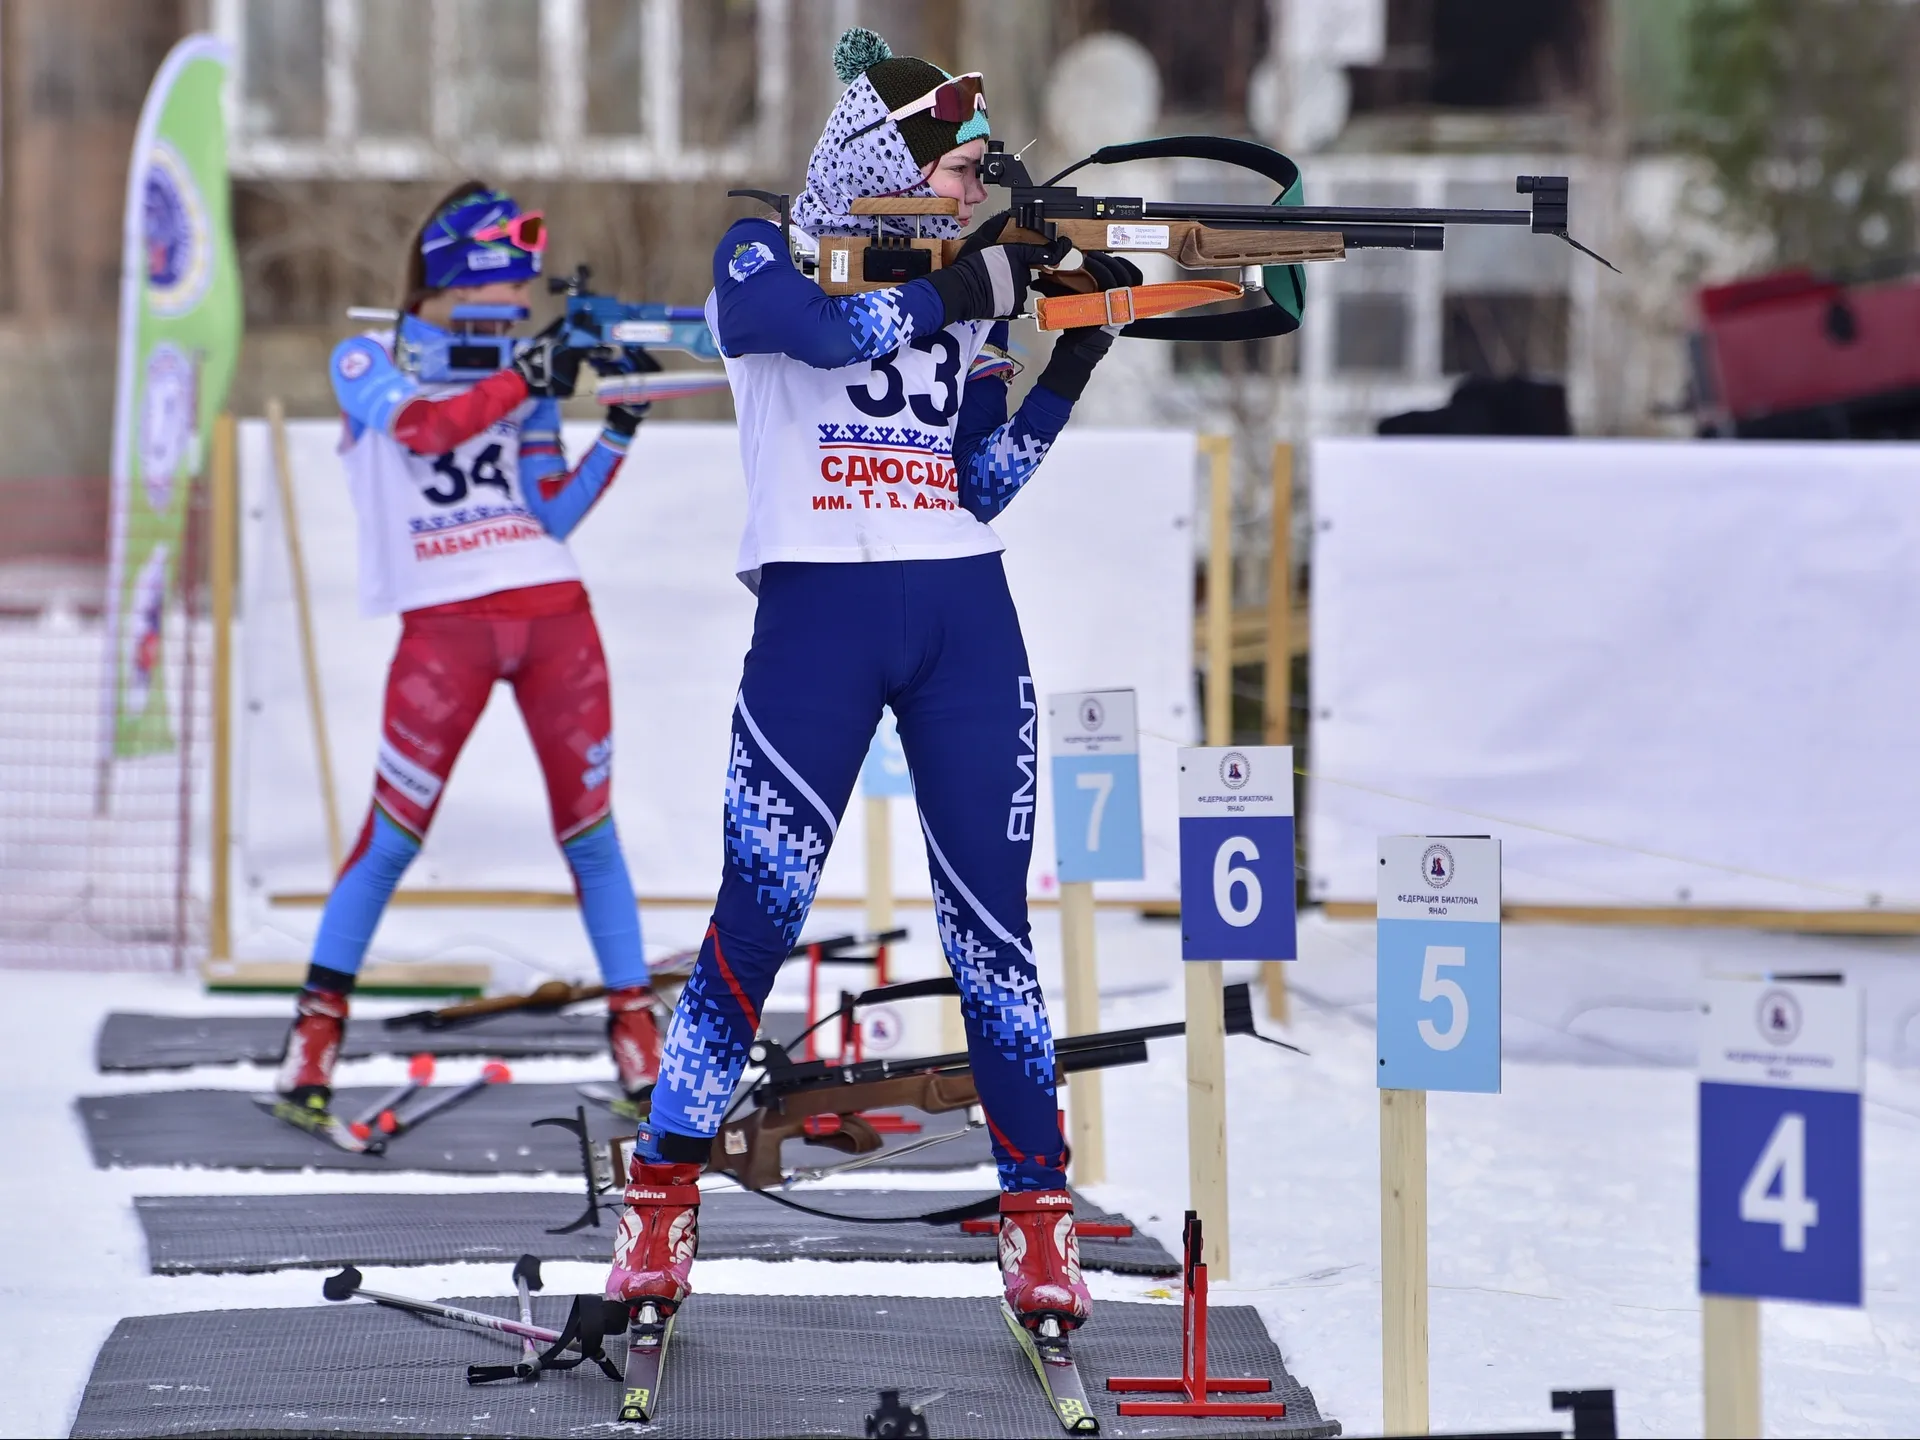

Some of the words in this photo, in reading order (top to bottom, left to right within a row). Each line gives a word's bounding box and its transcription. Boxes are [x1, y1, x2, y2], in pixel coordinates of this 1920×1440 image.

[845, 329, 961, 427] 33
[408, 443, 514, 506] 34
[812, 496, 852, 510] им.
[859, 490, 881, 509] Т.
[886, 492, 907, 509] В.
[1006, 675, 1037, 842] ЯМАЛ
[1075, 772, 1115, 852] 7
[1198, 795, 1237, 804] ФЕДЕРАЦИЯ
[1238, 795, 1274, 803] БИАТЛОНА
[1213, 836, 1263, 928] 6
[1397, 894, 1439, 904] ФЕДЕРАЦИЯ
[1441, 896, 1479, 905] БИАТЛОНА
[1428, 907, 1448, 915] ЯНАО
[1417, 945, 1469, 1052] 5
[626, 1189, 667, 1200] alpina
[1738, 1112, 1819, 1253] 4
